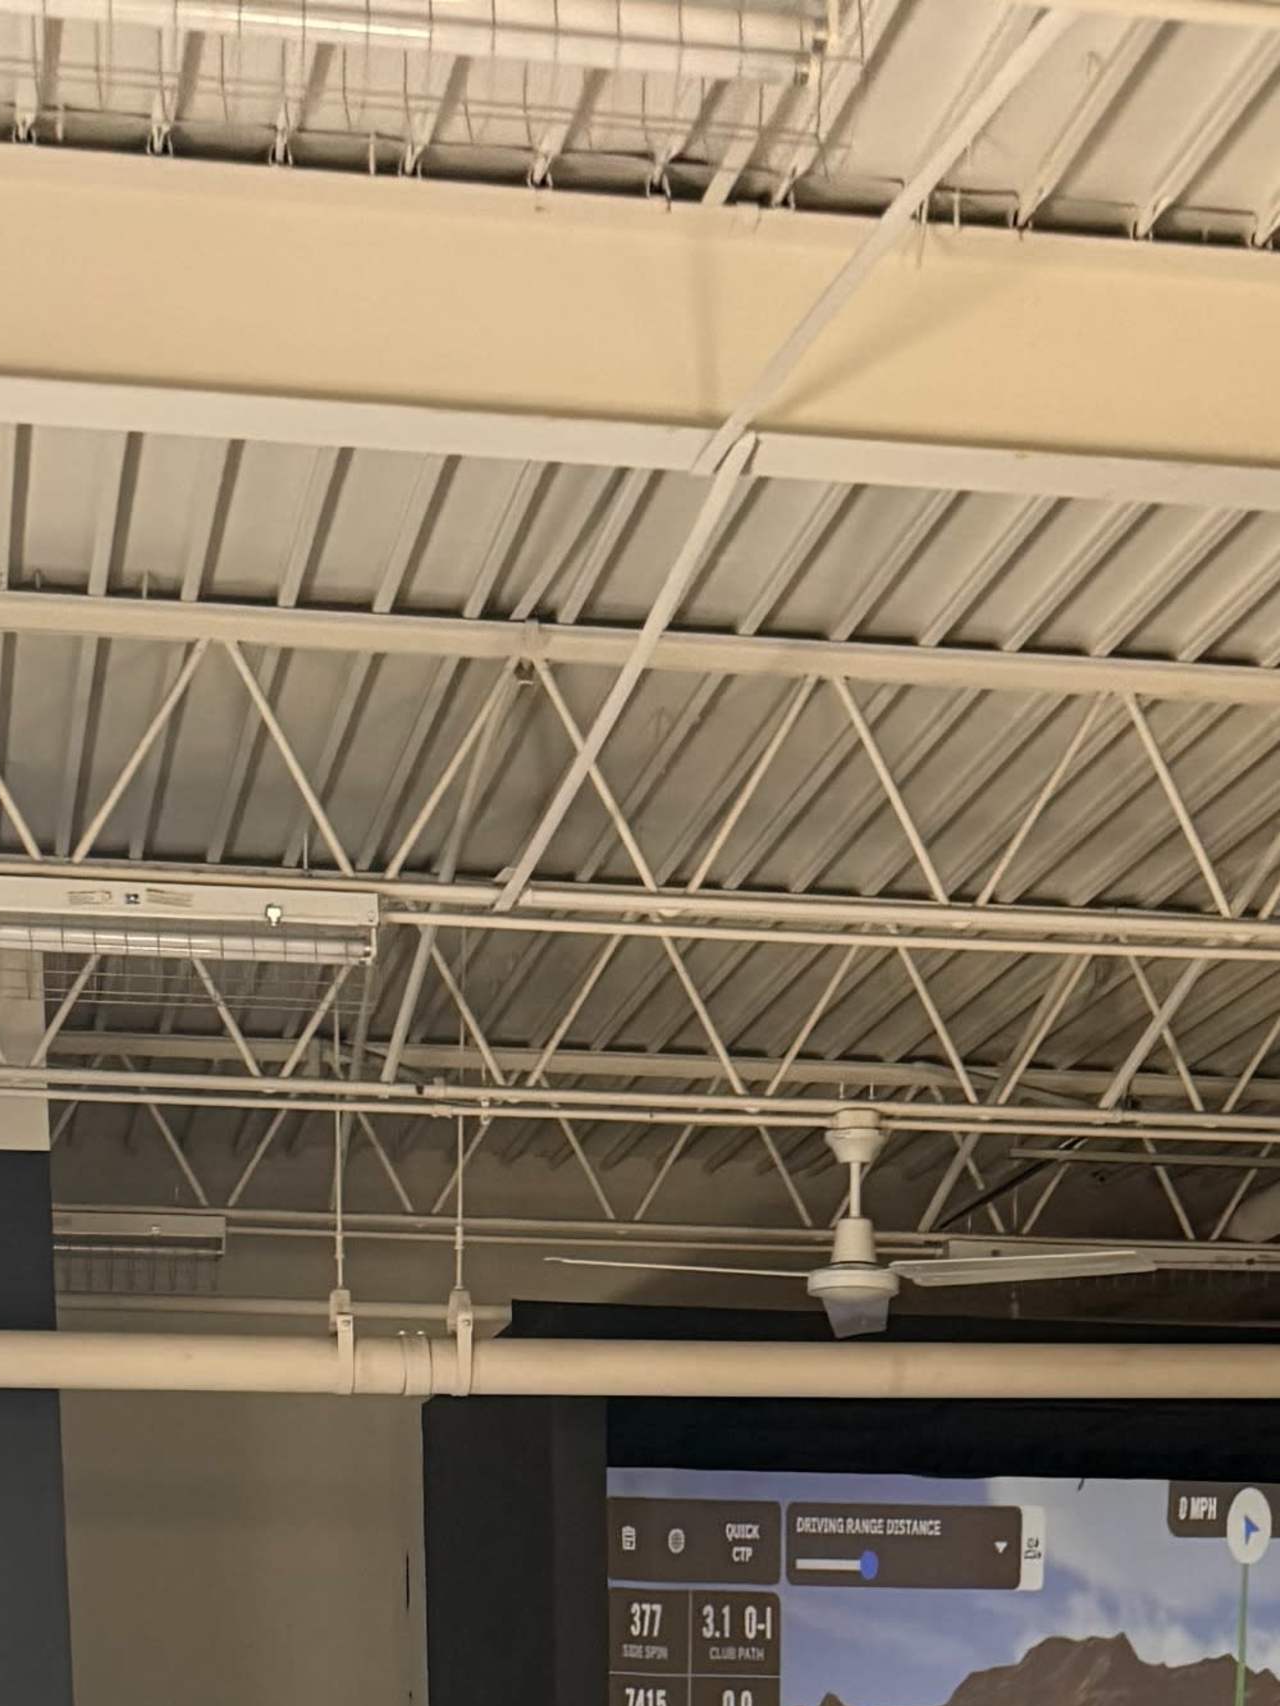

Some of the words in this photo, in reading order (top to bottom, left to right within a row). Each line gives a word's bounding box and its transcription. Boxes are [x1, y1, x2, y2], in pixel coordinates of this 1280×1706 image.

[1189, 1496, 1217, 1520] MPH
[725, 1523, 760, 1541] QUICK
[796, 1516, 844, 1535] DRIVING
[846, 1517, 885, 1535] RANGE
[886, 1518, 942, 1536] DISTANCE
[732, 1547, 753, 1562] CTP
[630, 1602, 662, 1637] 377
[702, 1604, 731, 1639] 3.1
[738, 1647, 765, 1660] PATH
